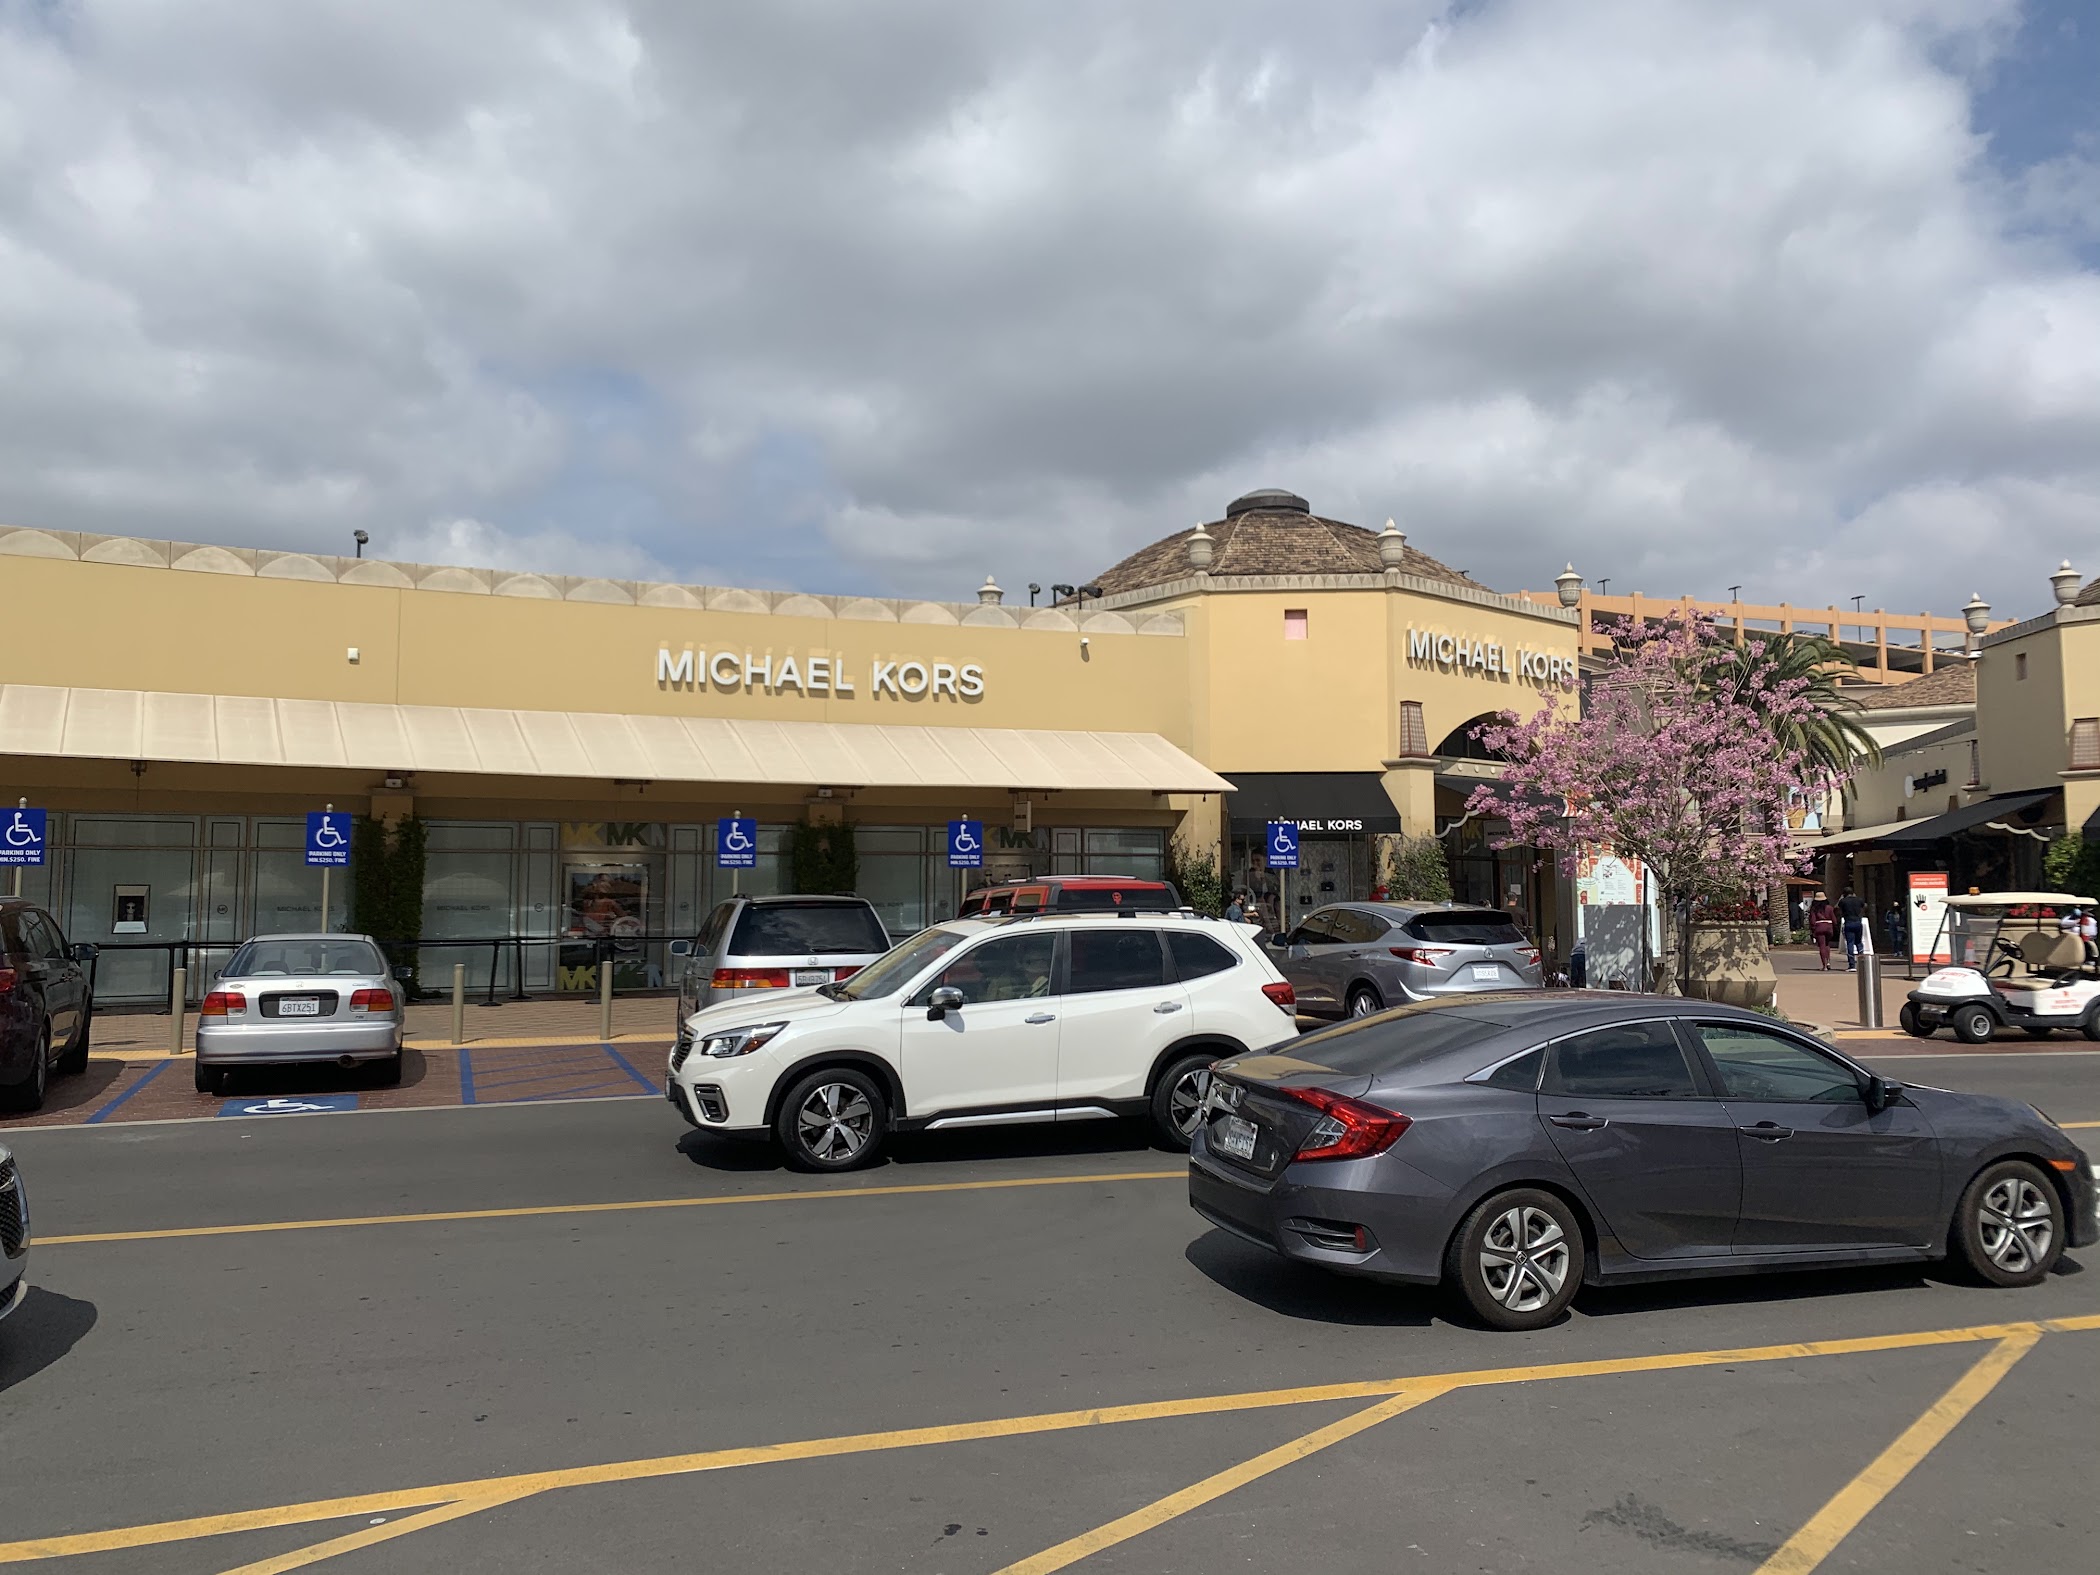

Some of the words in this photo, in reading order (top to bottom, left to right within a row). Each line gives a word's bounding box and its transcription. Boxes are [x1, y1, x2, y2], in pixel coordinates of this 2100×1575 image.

[1408, 628, 1513, 674] MICHAEL
[1515, 648, 1576, 682] KORS
[657, 648, 855, 691] MICHAEL
[871, 660, 985, 697] KORS
[606, 822, 650, 846] MK
[1327, 819, 1363, 831] KORS
[281, 1002, 316, 1014] 6BTX251
